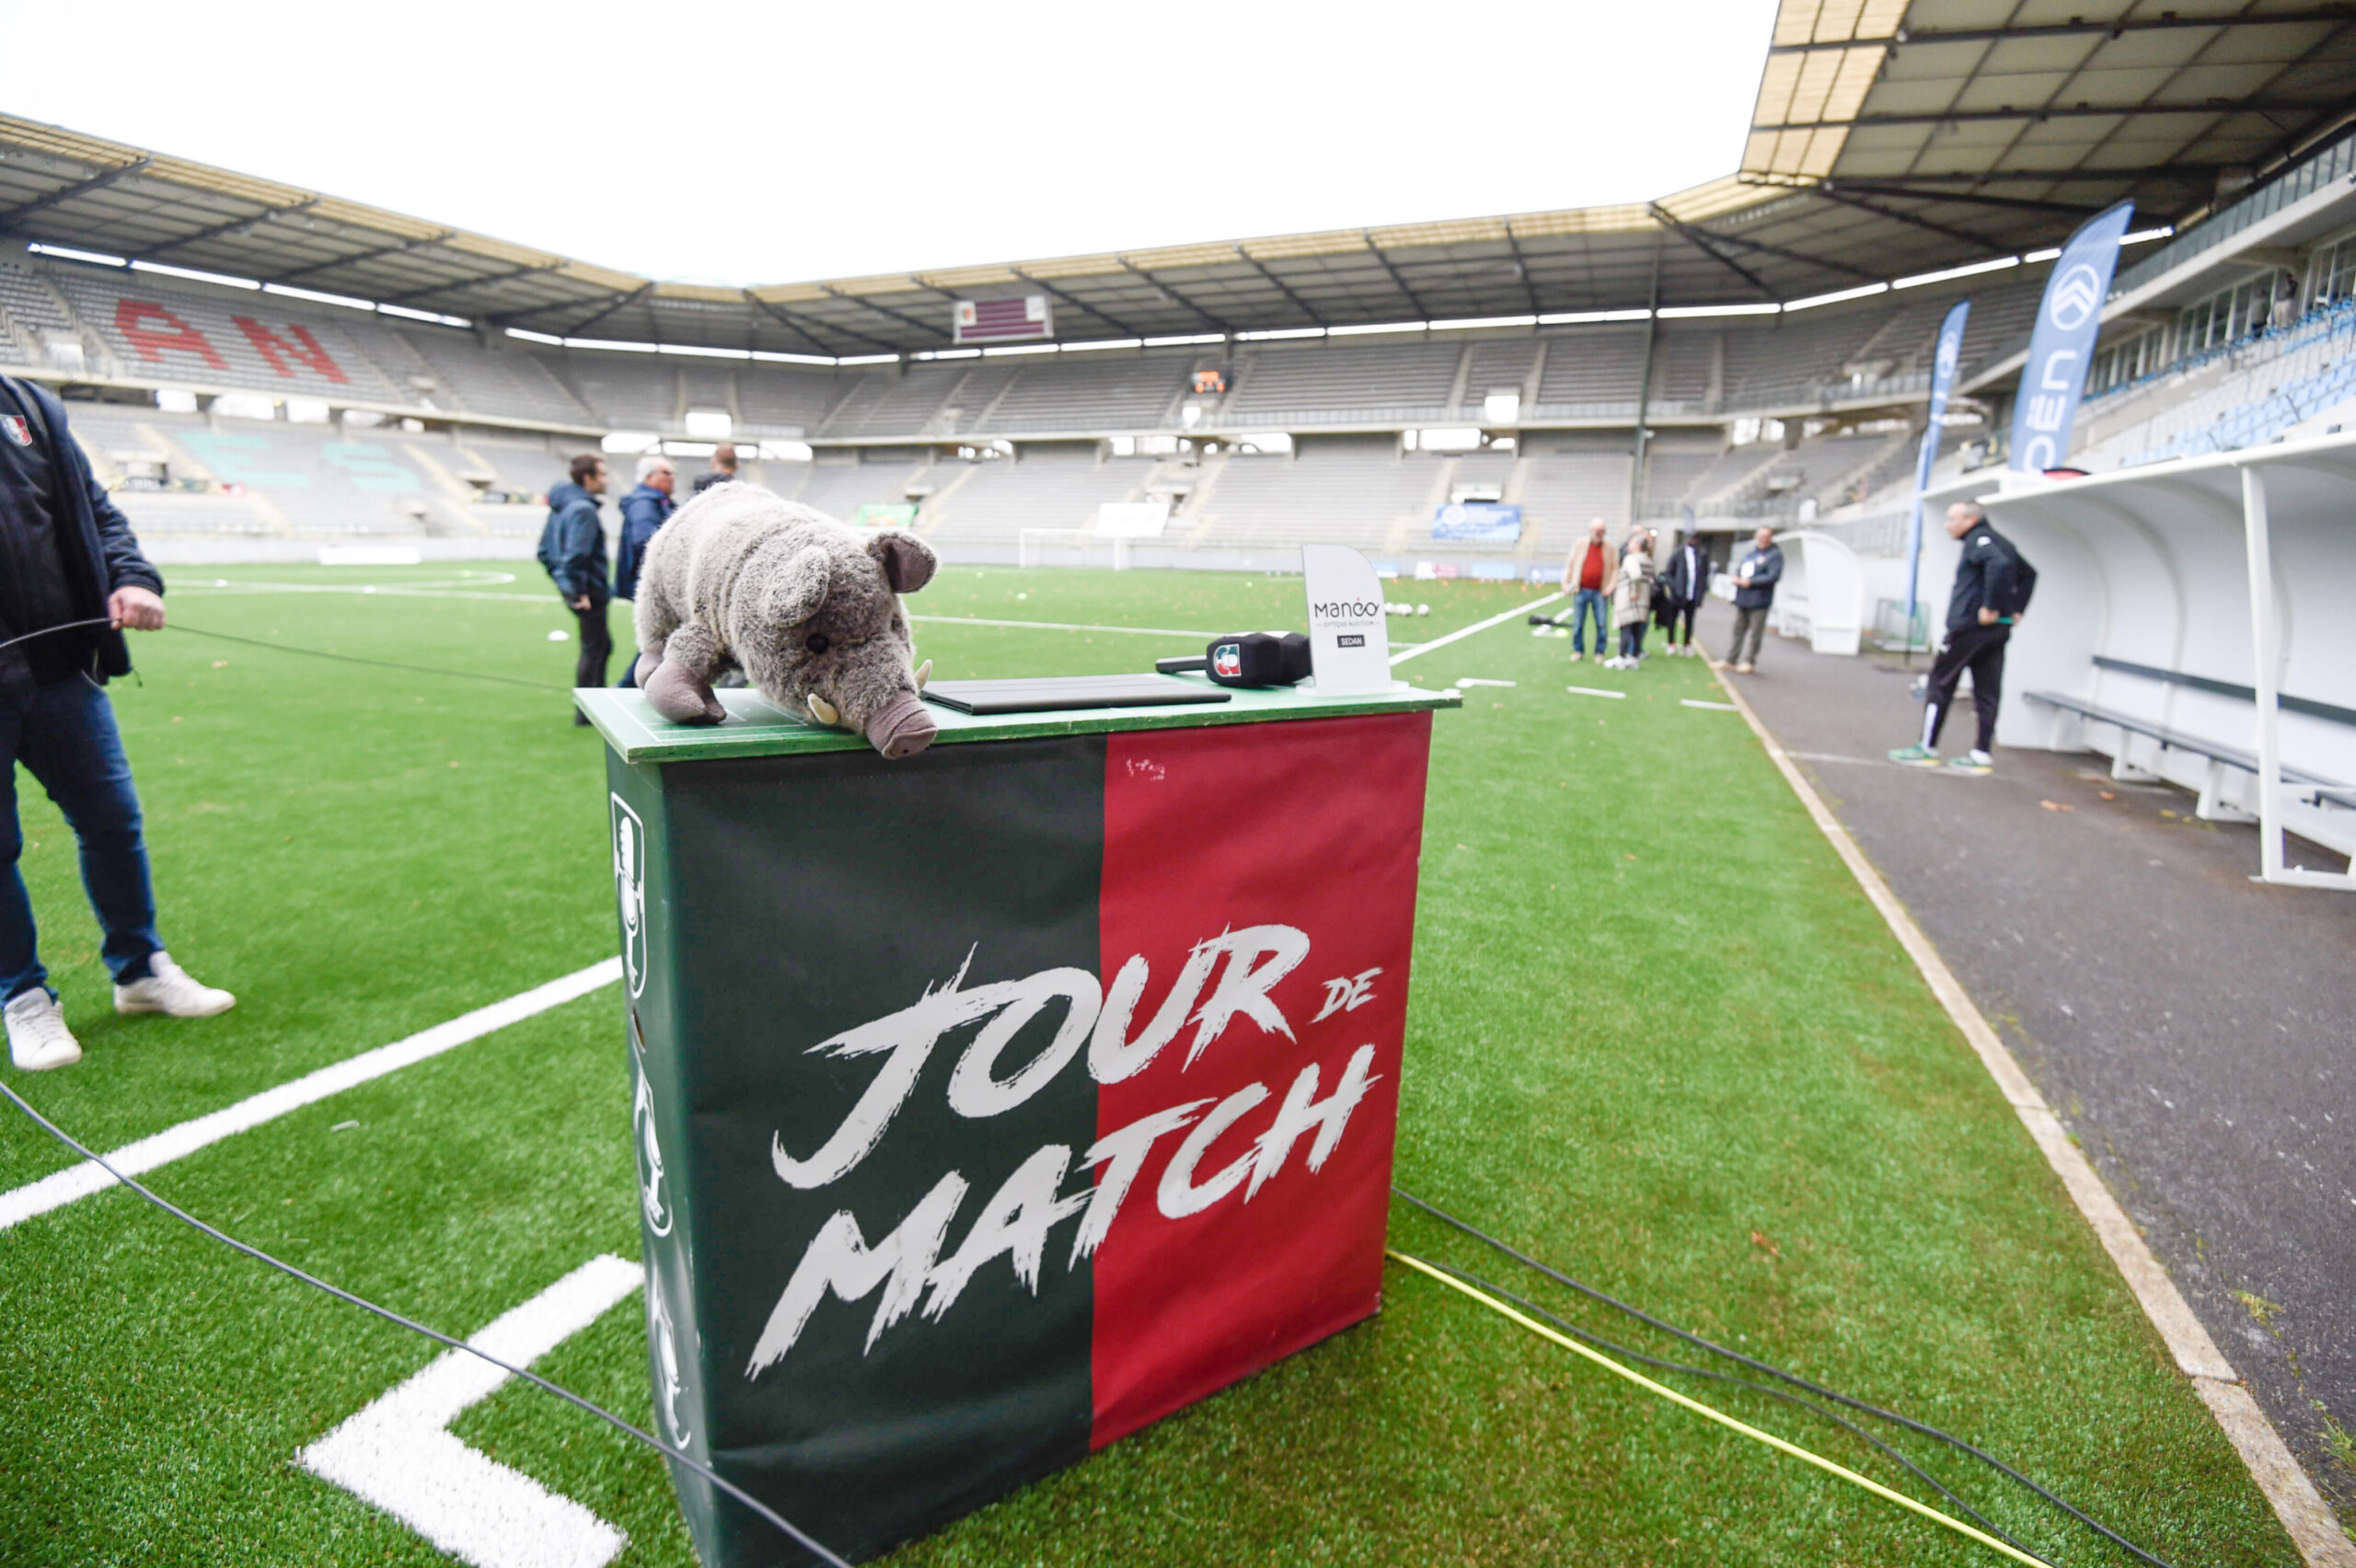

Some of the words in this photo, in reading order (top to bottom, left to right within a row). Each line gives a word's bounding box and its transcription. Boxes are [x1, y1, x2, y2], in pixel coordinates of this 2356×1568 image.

[1341, 637, 1362, 645] SEDAN
[771, 922, 1310, 1189] TOUR
[1311, 966, 1385, 1024] DE
[744, 1043, 1382, 1380] MATCH
